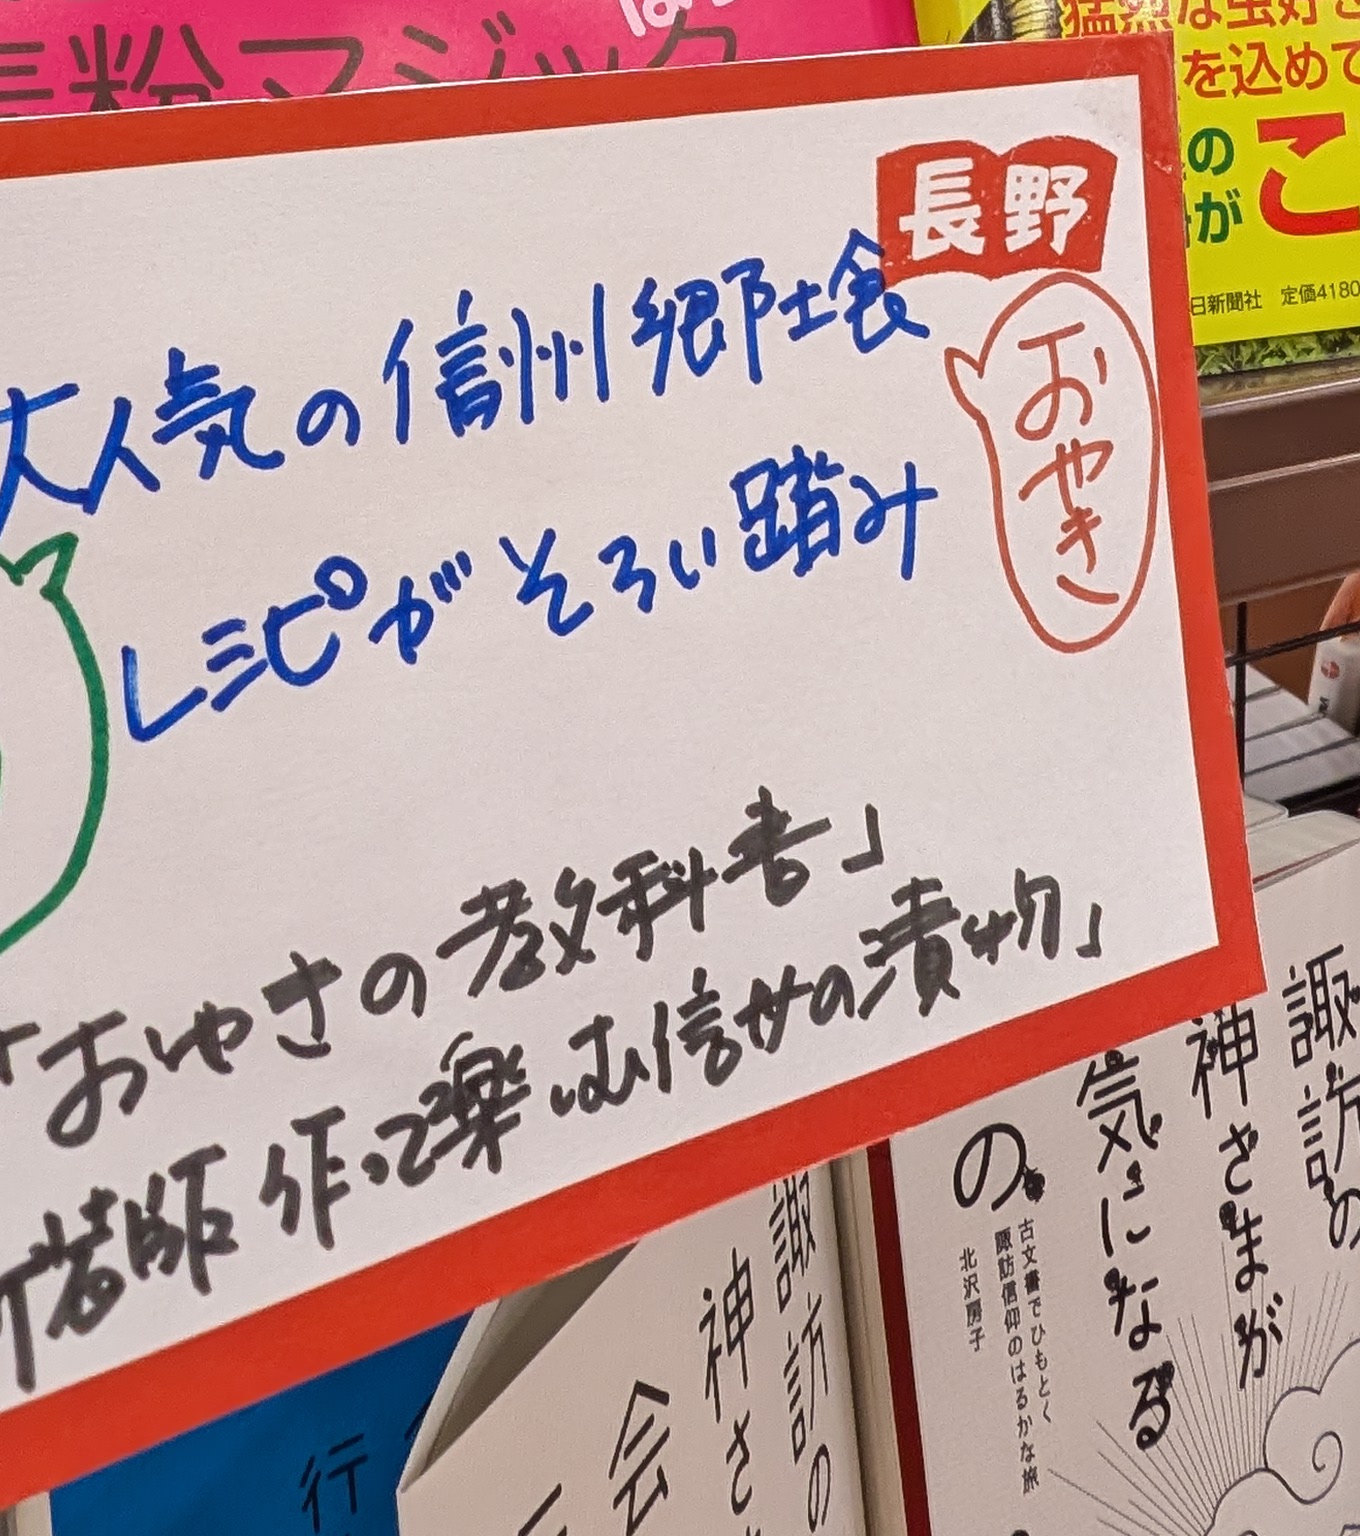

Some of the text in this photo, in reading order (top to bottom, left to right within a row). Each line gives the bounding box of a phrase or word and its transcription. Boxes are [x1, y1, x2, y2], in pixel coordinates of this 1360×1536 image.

[898, 156, 1089, 262] 長野
[1015, 320, 1120, 605] おやき
[121, 443, 938, 742] レシピがそろい踏み
[959, 1247, 987, 1352] 北沢房子
